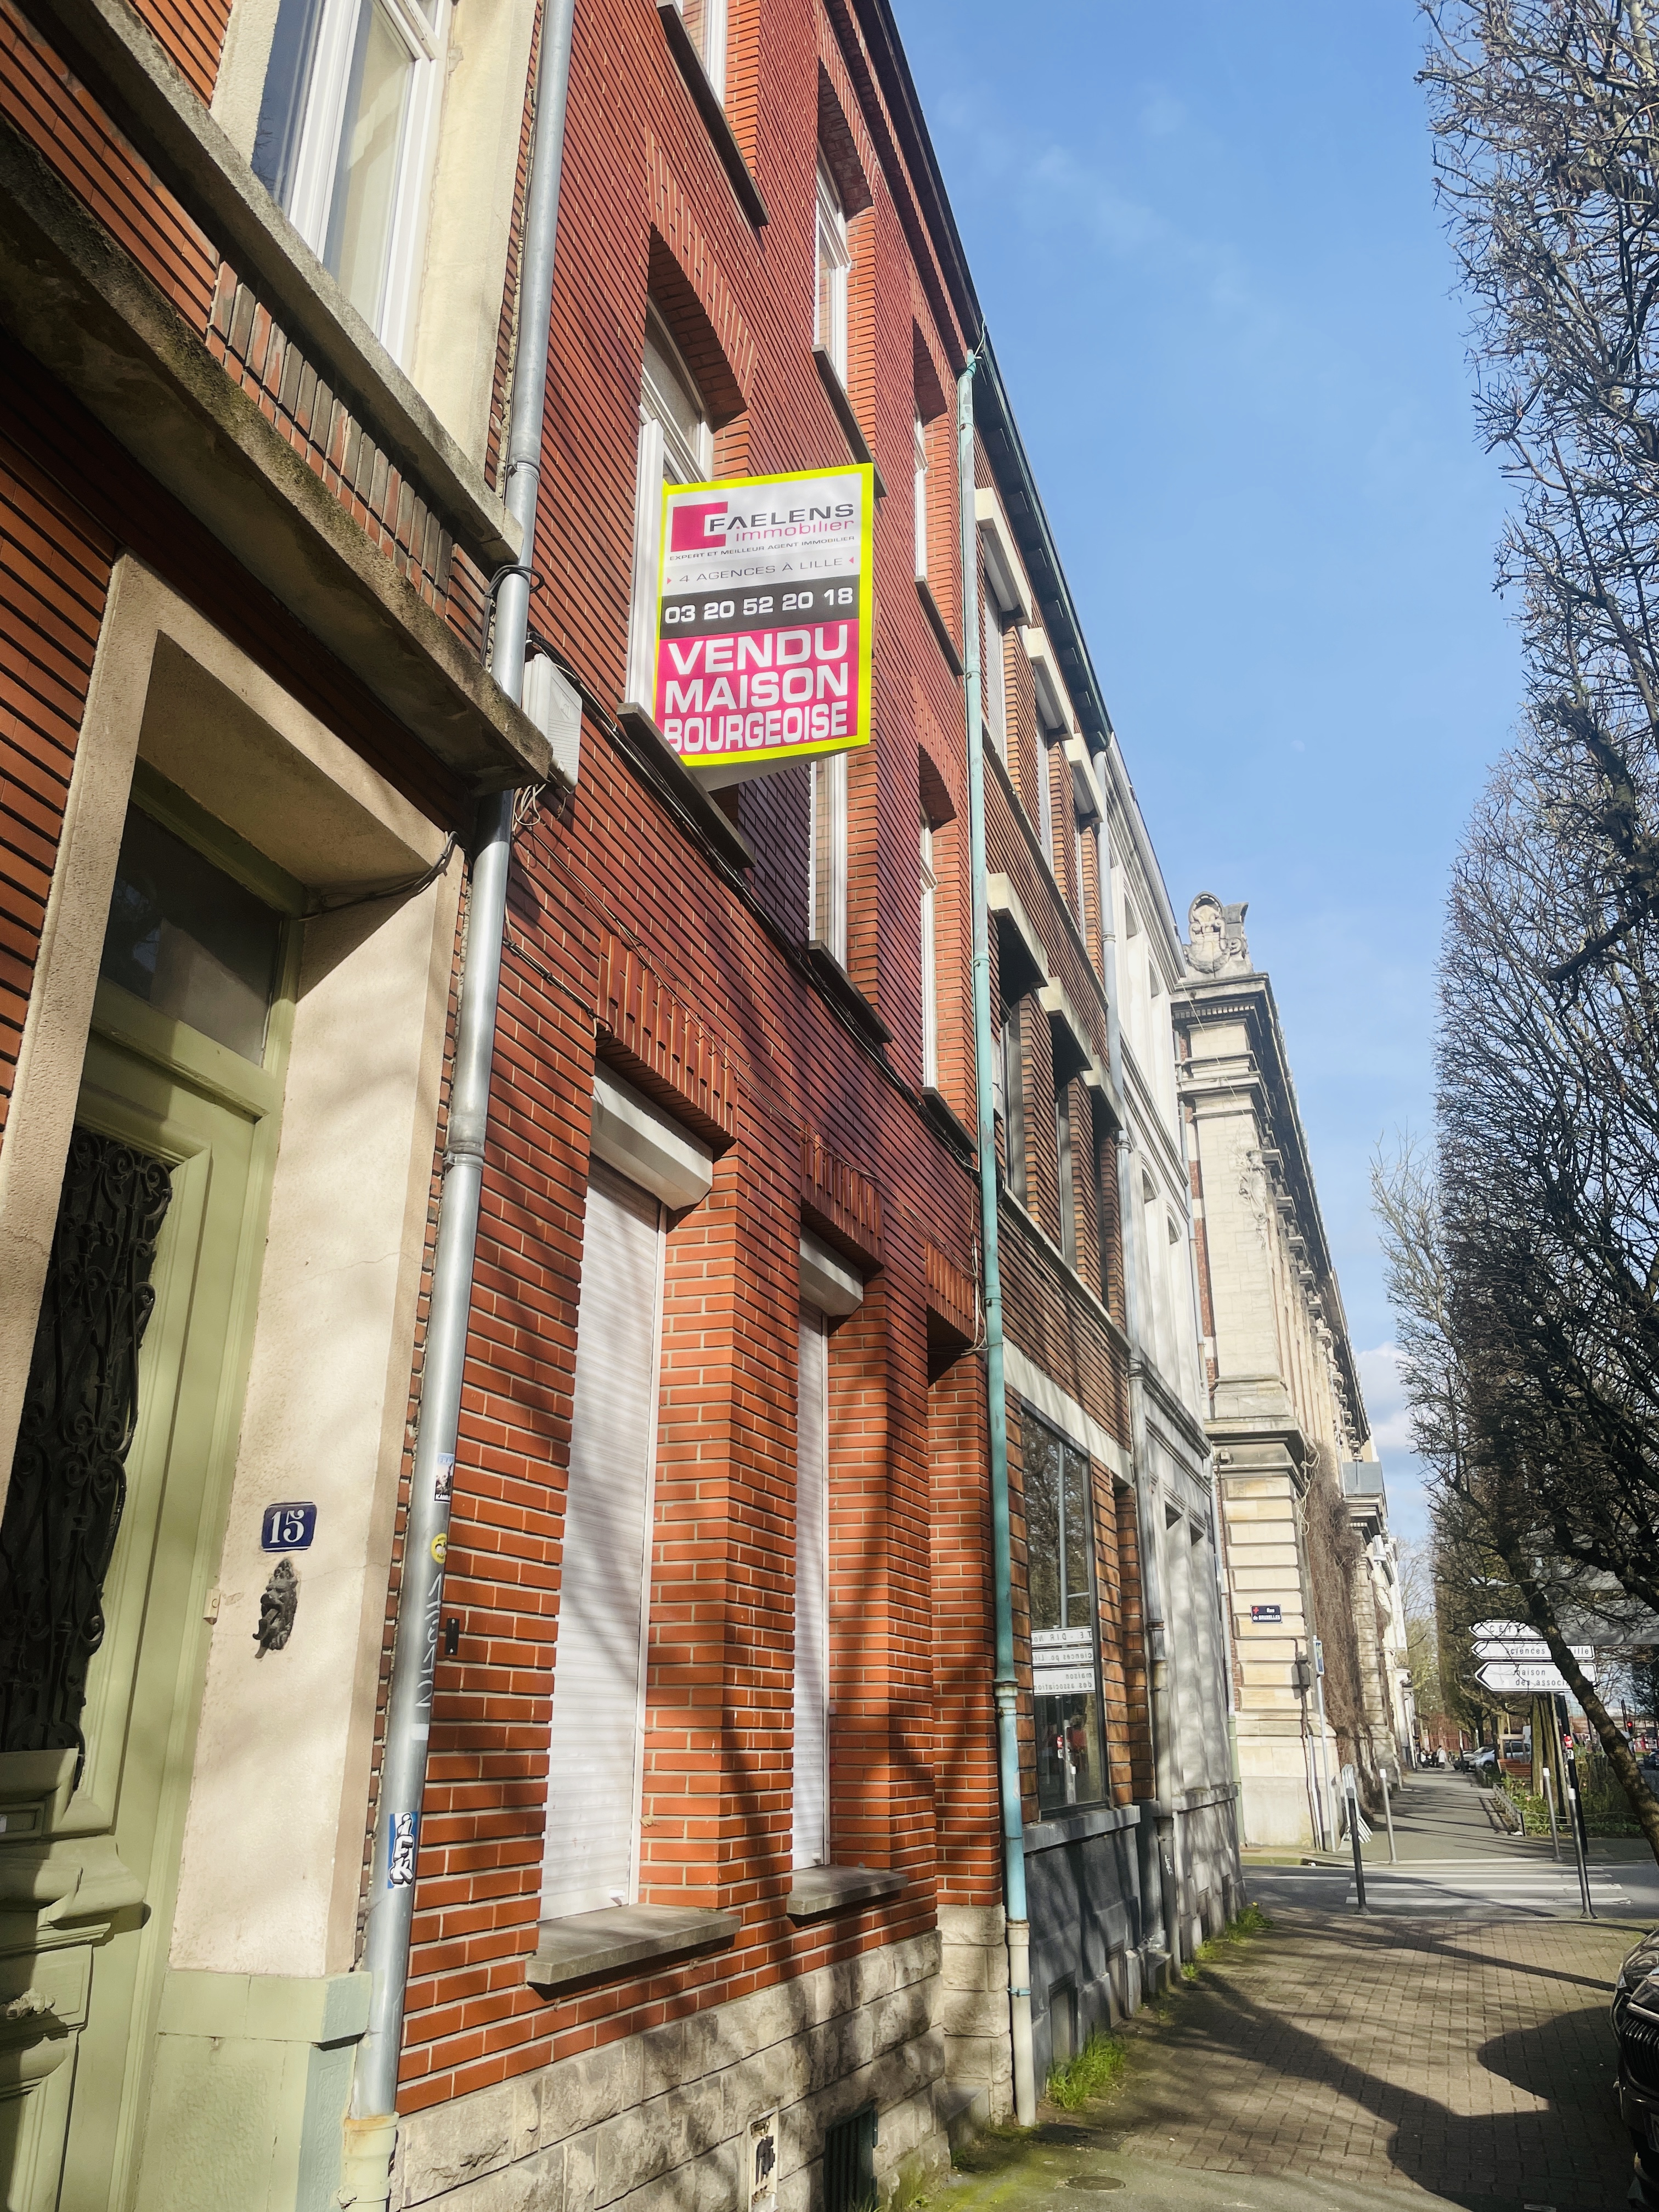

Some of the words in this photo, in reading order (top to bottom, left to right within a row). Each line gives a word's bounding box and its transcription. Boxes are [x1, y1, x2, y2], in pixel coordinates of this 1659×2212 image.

[710, 504, 854, 532] FAELENS
[736, 520, 854, 541] immobilier
[670, 552, 704, 561] EXPERT
[721, 546, 764, 555] MEILLEUR
[802, 536, 854, 546] IMMOBILIER
[696, 566, 775, 582] AGENCES
[782, 562, 793, 572] À
[800, 557, 843, 570] LILLE
[665, 605, 696, 624] 03
[704, 600, 735, 620] 20
[743, 596, 774, 615] 52
[782, 591, 814, 611] 20
[823, 587, 853, 606] 18
[668, 624, 848, 675] VENDU
[665, 662, 848, 714] MAISON
[664, 701, 848, 752] BOURGEOISE
[269, 1509, 304, 1543] 15
